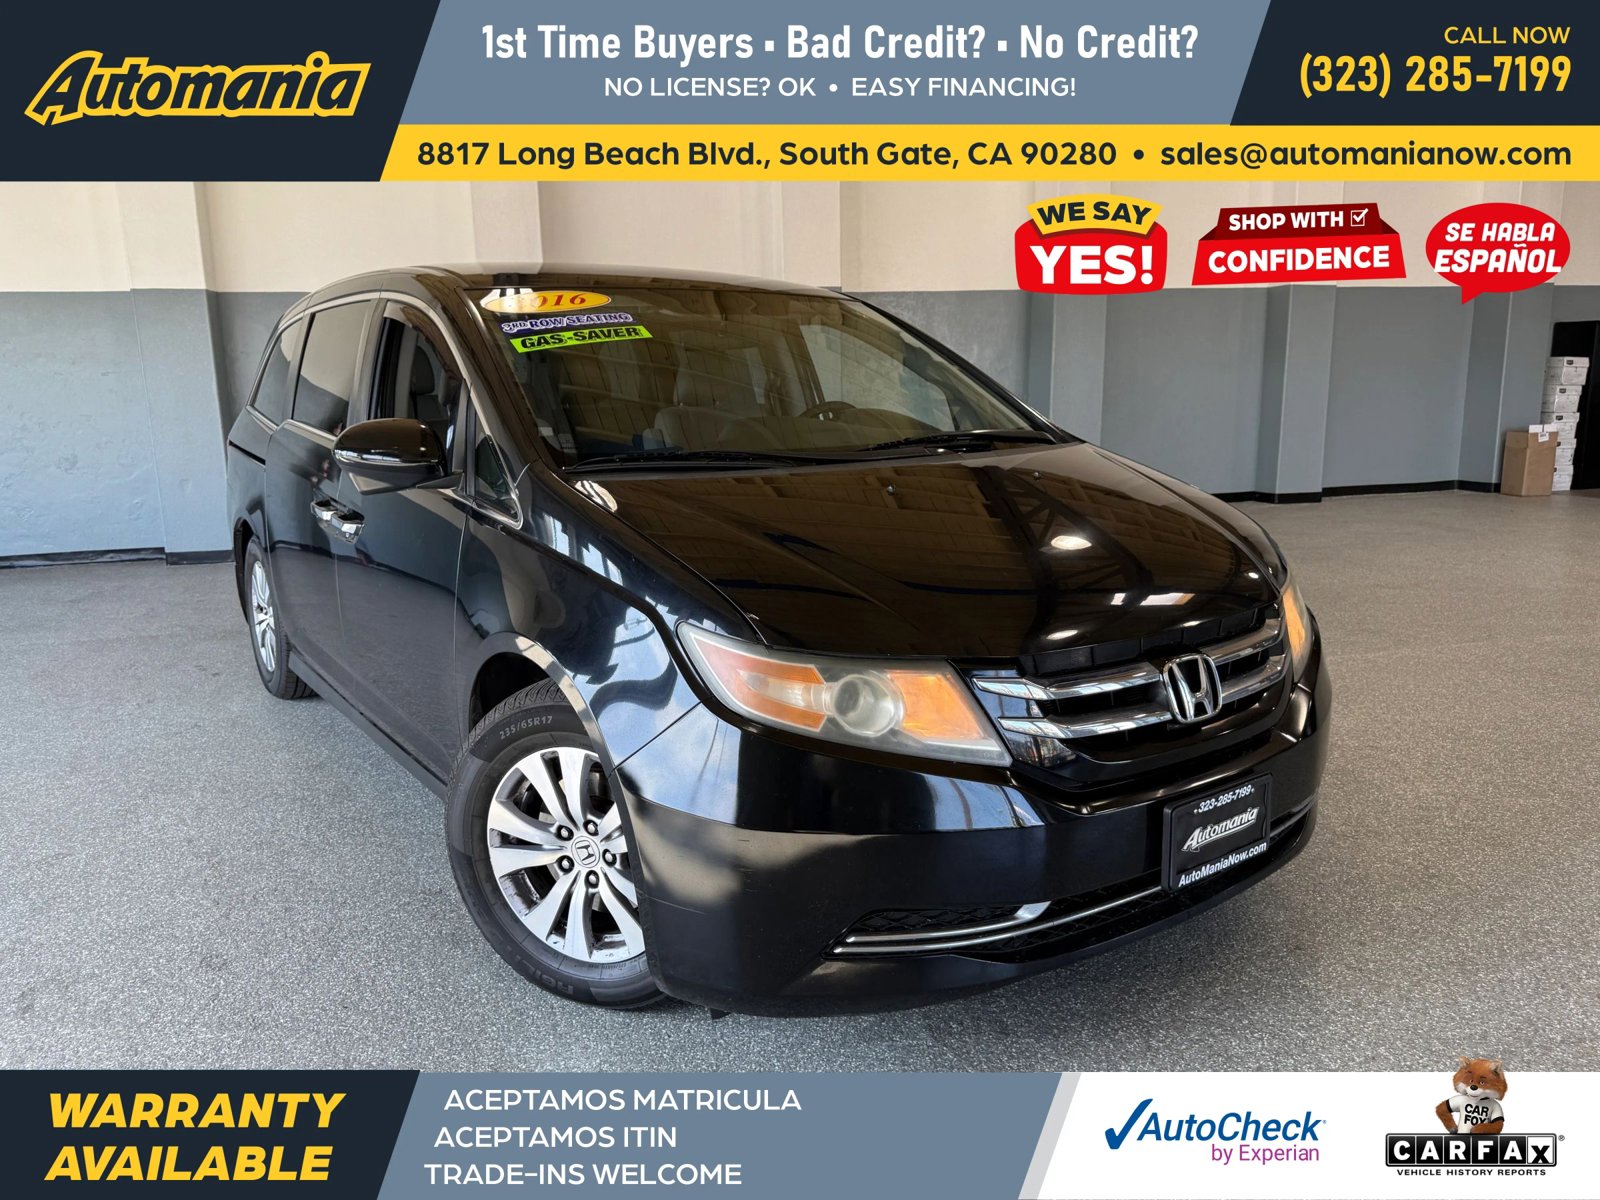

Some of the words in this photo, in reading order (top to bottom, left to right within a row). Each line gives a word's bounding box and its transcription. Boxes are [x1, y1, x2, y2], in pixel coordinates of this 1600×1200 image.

[528, 317, 563, 330] ROW
[566, 312, 632, 328] SEATING
[520, 327, 640, 349] GAS-SAVER
[499, 715, 553, 740] 235/65R17
[1181, 807, 1260, 852] Automania
[1178, 842, 1267, 887] AutoManiaNow.com
